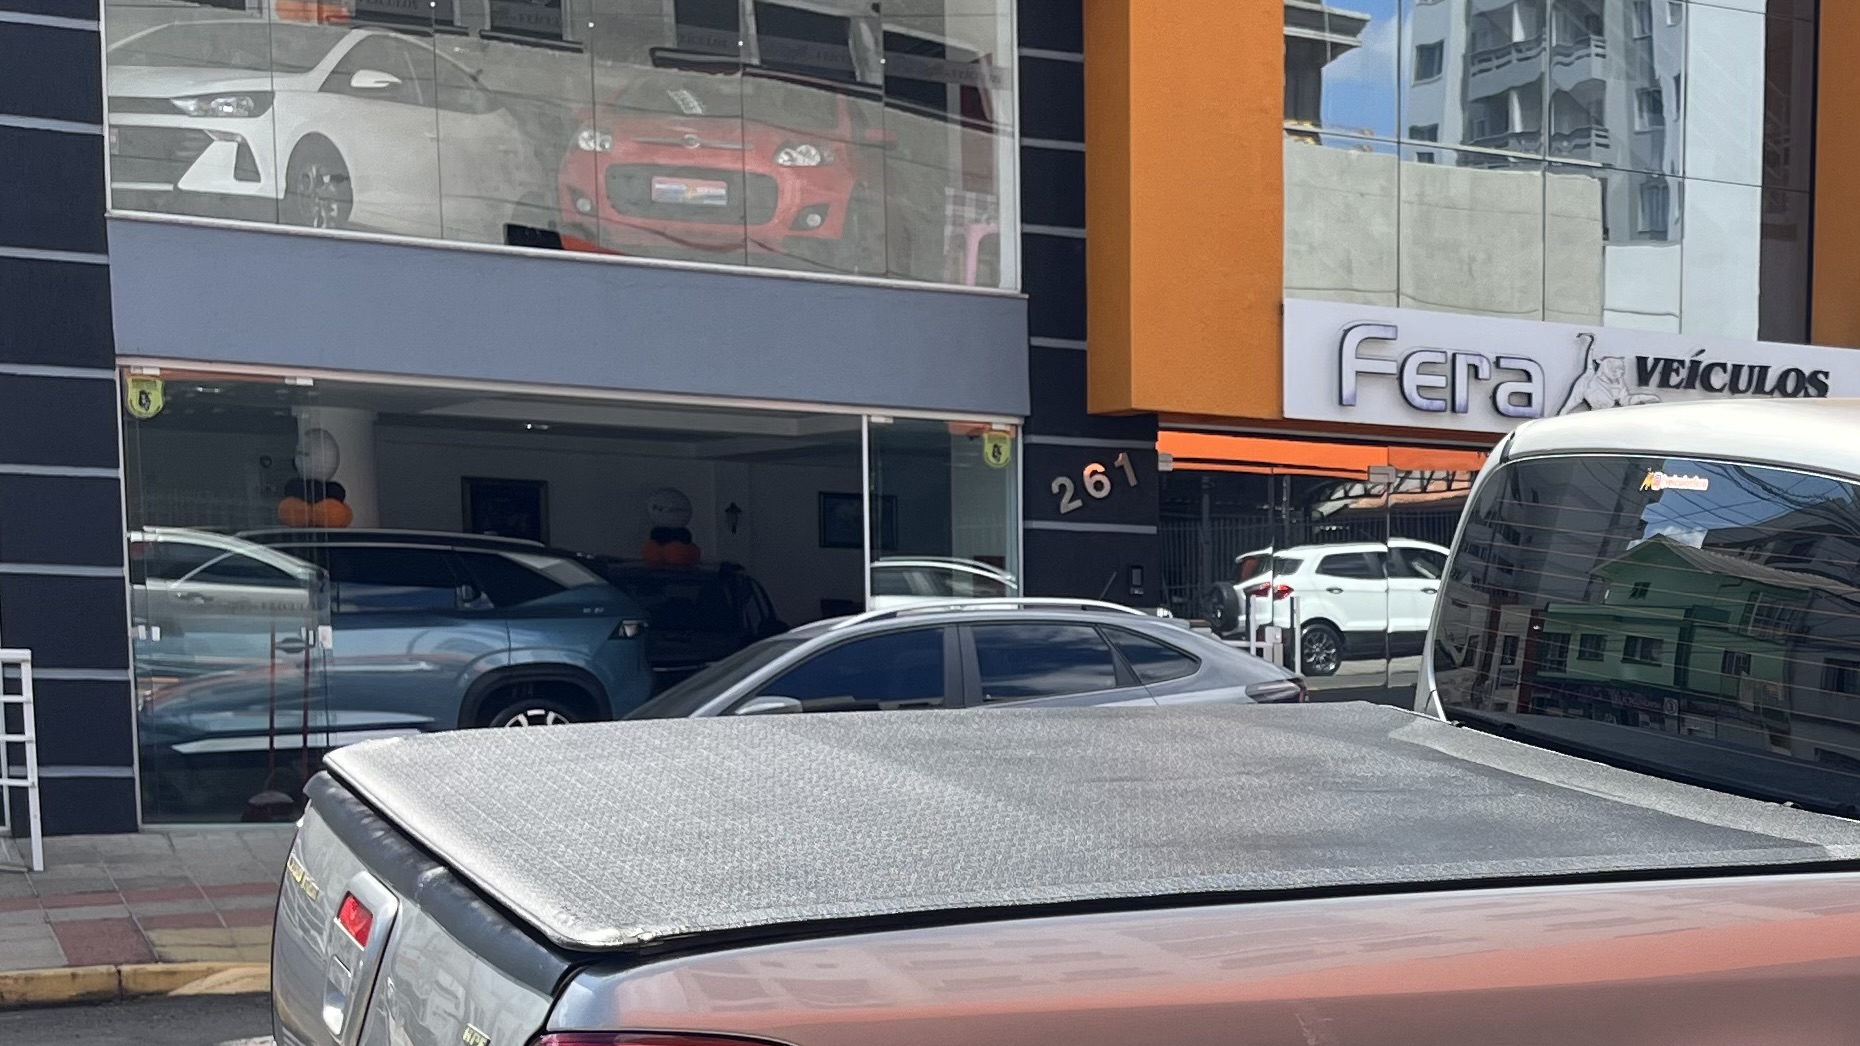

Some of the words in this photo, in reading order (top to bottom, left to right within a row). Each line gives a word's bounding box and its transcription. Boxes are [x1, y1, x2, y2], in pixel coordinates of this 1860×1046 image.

[1338, 322, 1546, 418] Fera
[1635, 349, 1831, 398] VEÍCULOS
[1051, 452, 1138, 515] 261
